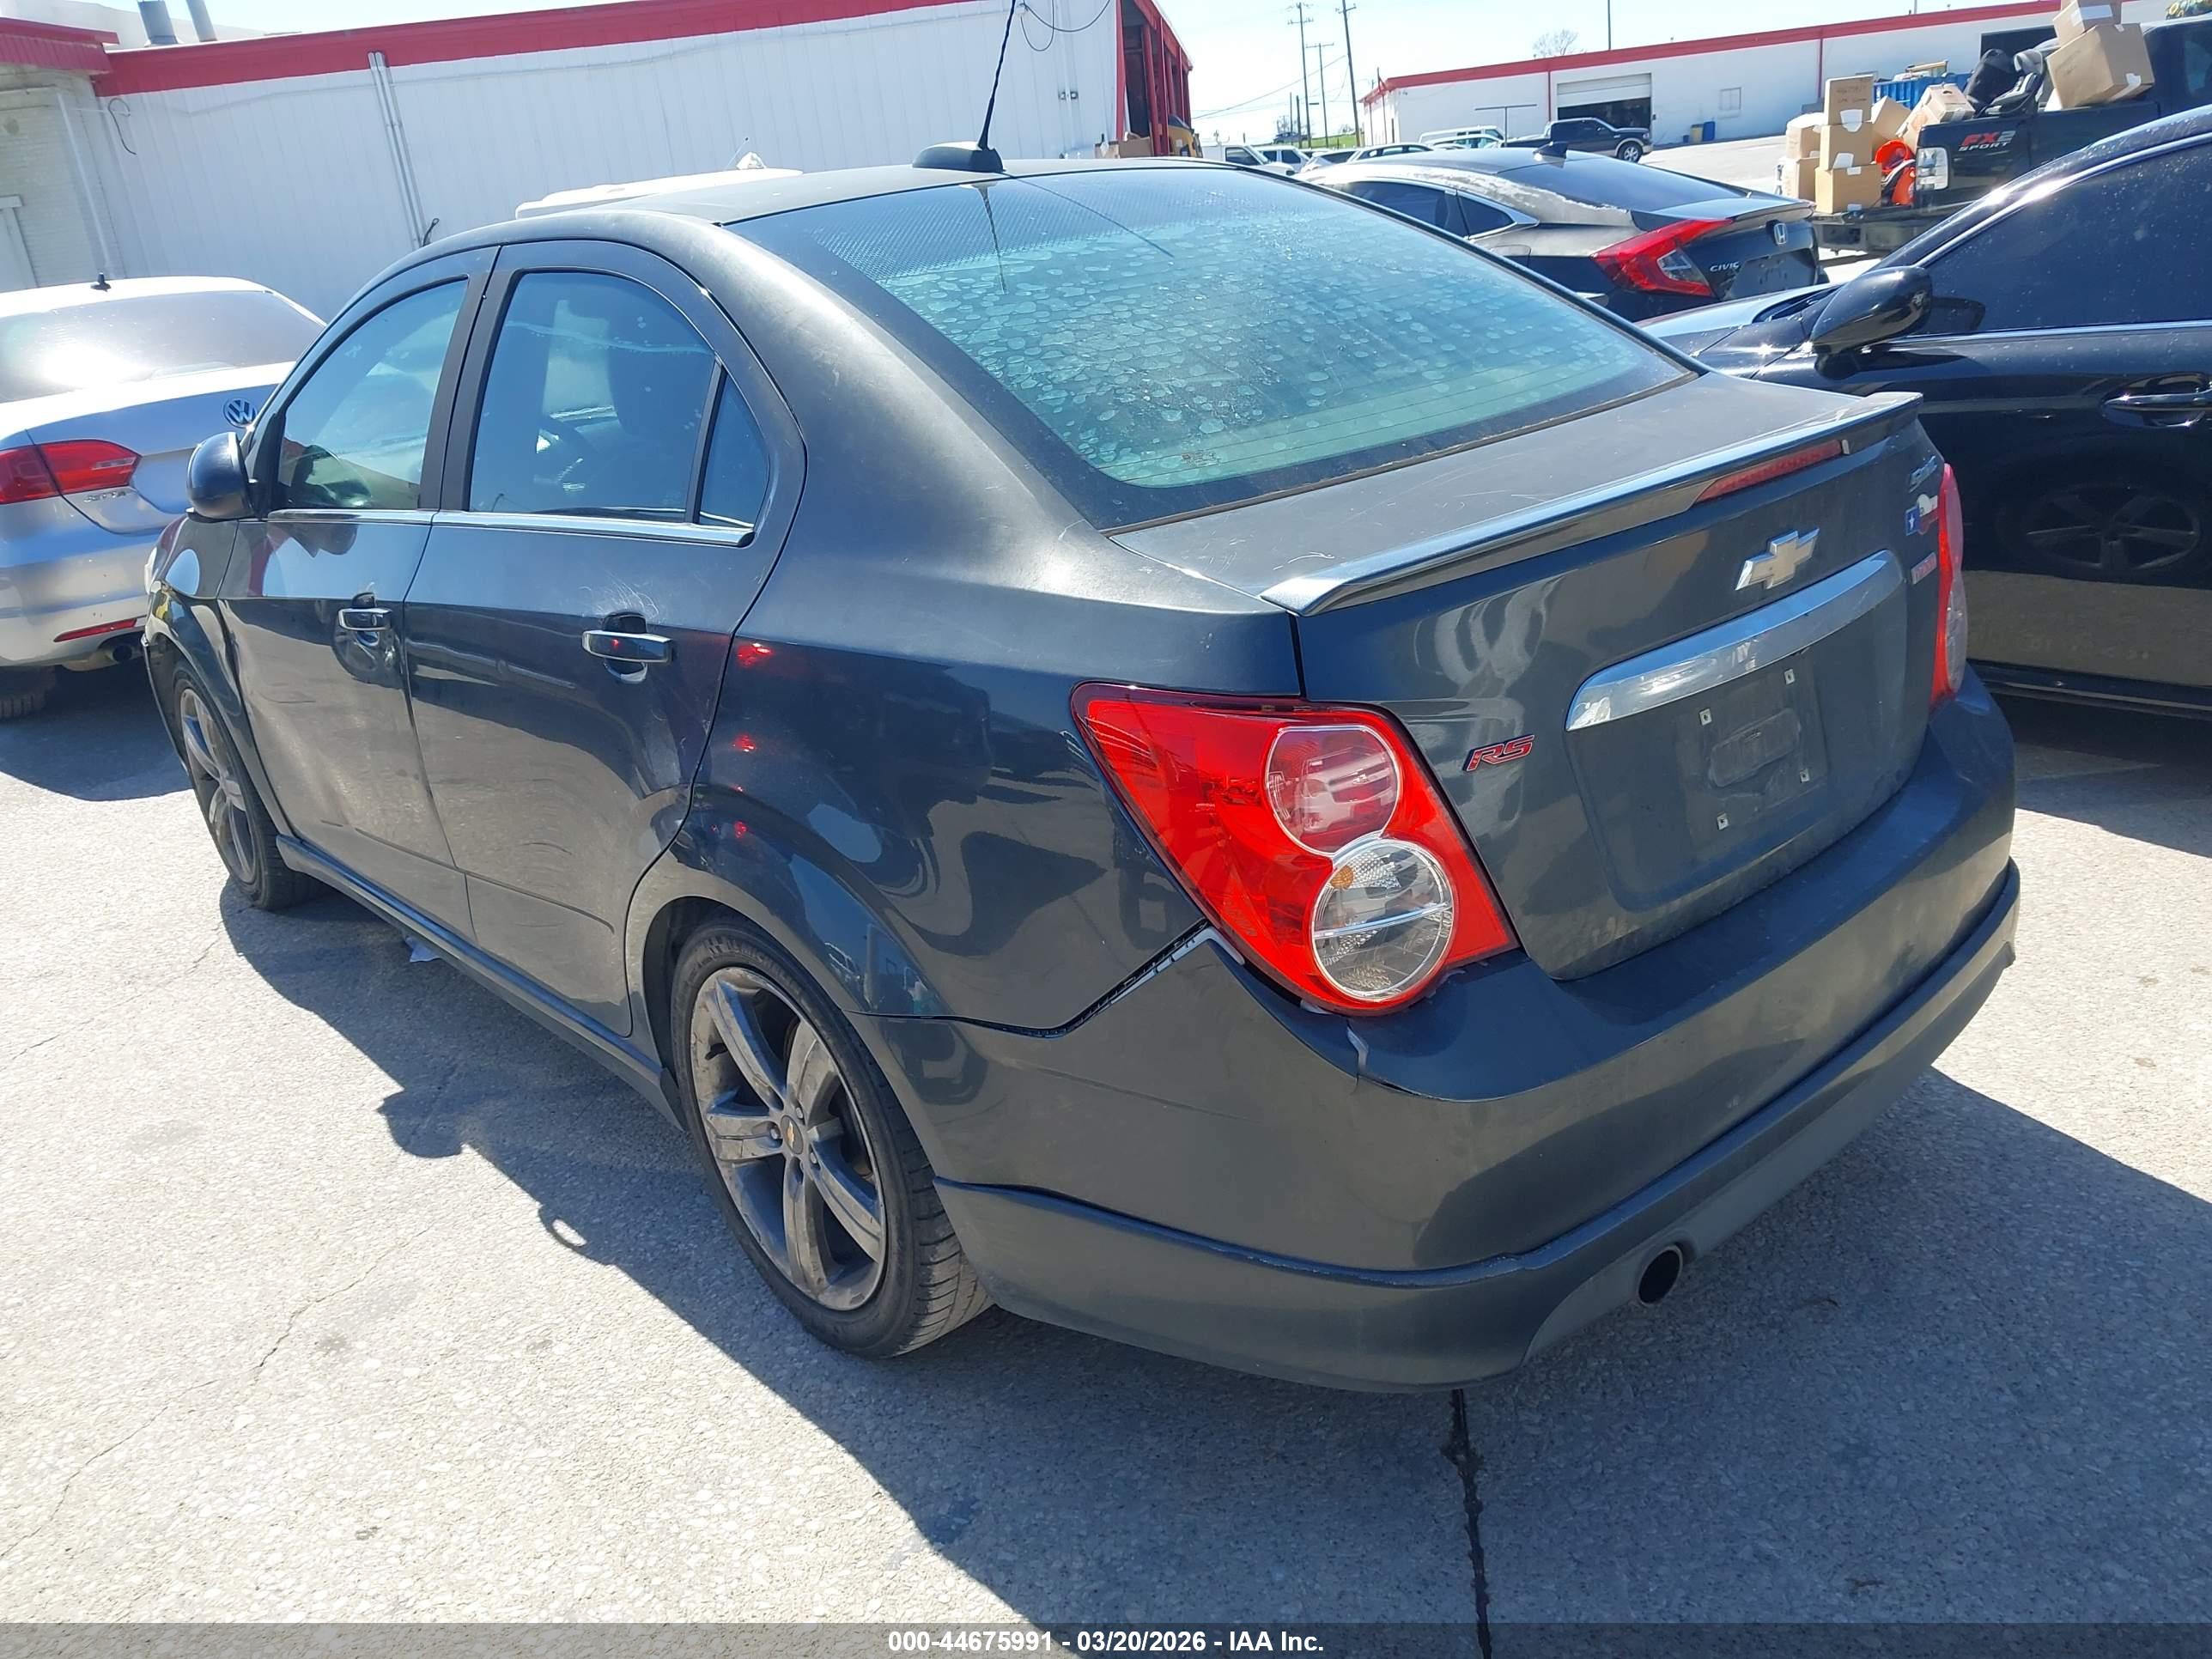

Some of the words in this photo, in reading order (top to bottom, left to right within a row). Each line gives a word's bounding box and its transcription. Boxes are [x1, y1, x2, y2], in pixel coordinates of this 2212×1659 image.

[1960, 131, 2016, 146] FX2
[1958, 142, 2011, 151] SPORT
[1710, 261, 1740, 272] CIVIC
[1462, 734, 1535, 772] RS
